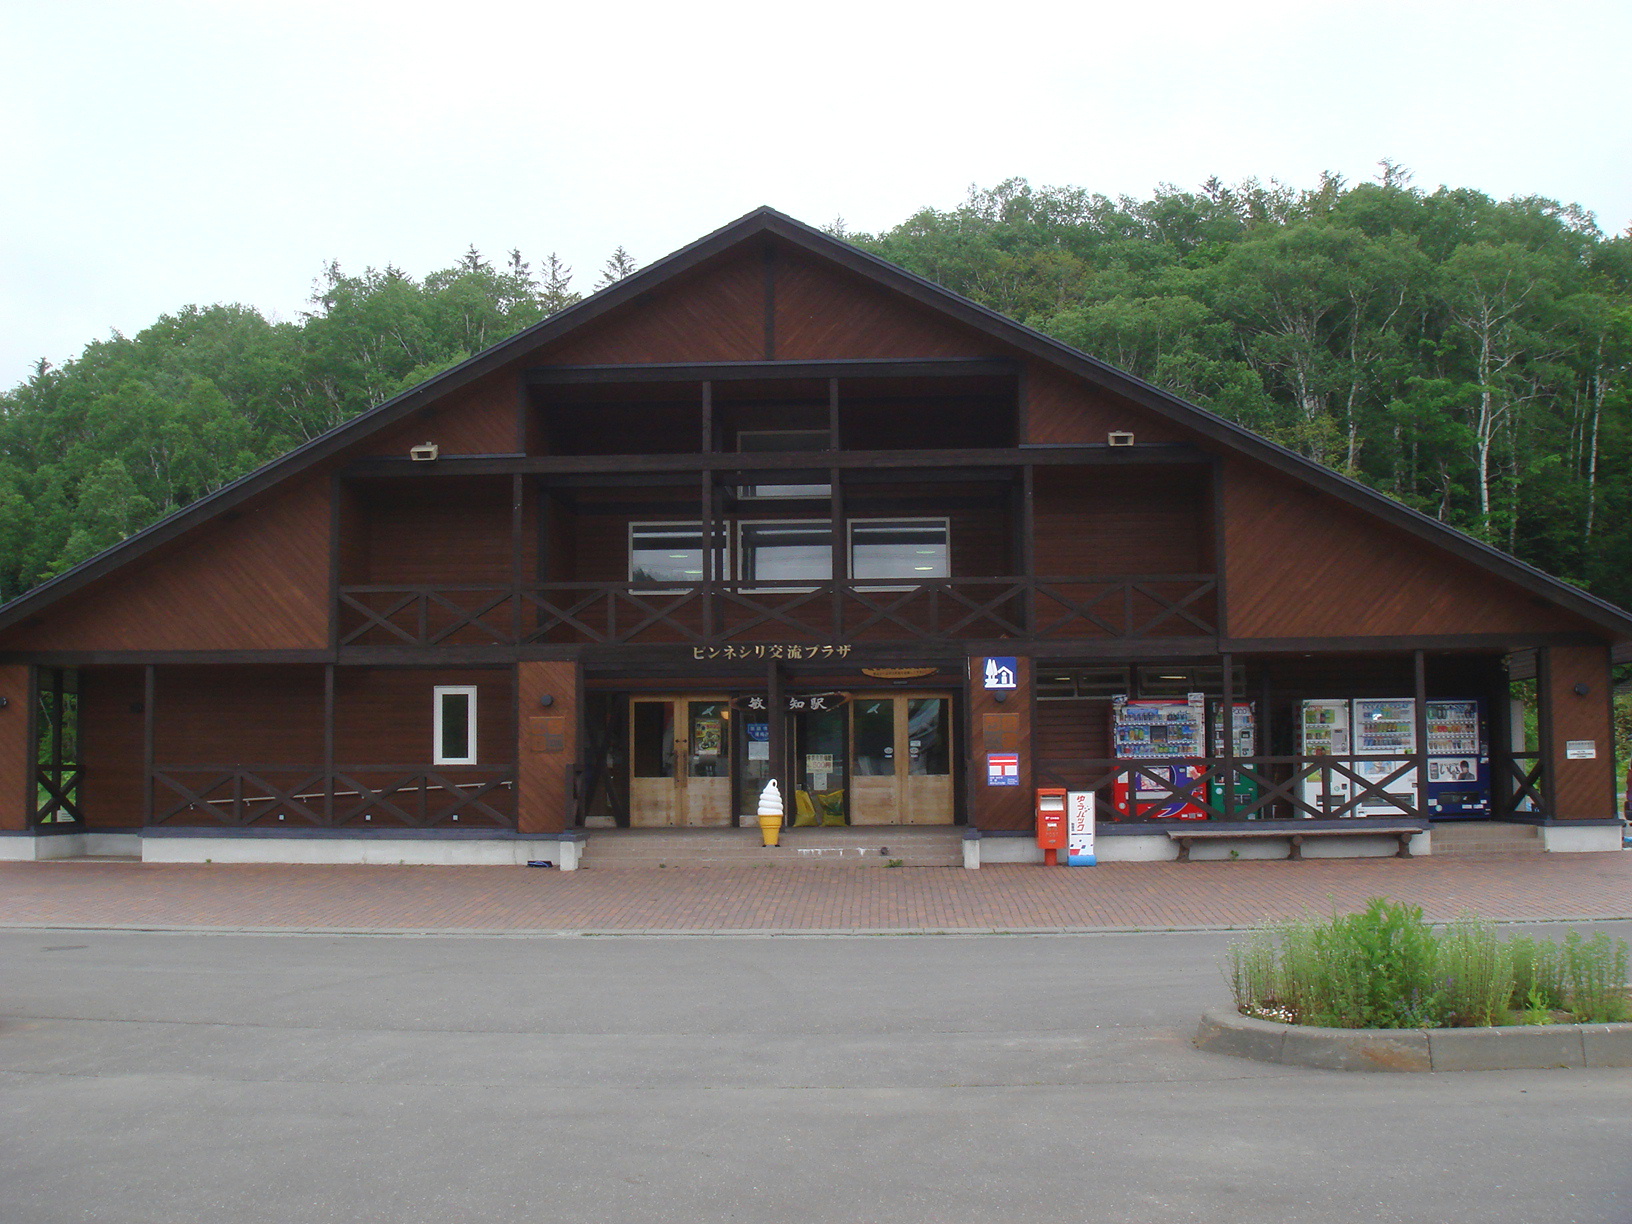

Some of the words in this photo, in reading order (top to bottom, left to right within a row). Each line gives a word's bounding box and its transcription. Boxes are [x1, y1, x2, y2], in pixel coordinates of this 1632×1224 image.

[693, 644, 852, 660] ピンネシリ交流プラザ
[748, 697, 828, 710] 敏知駅
[1076, 795, 1088, 832] ゆうパック
